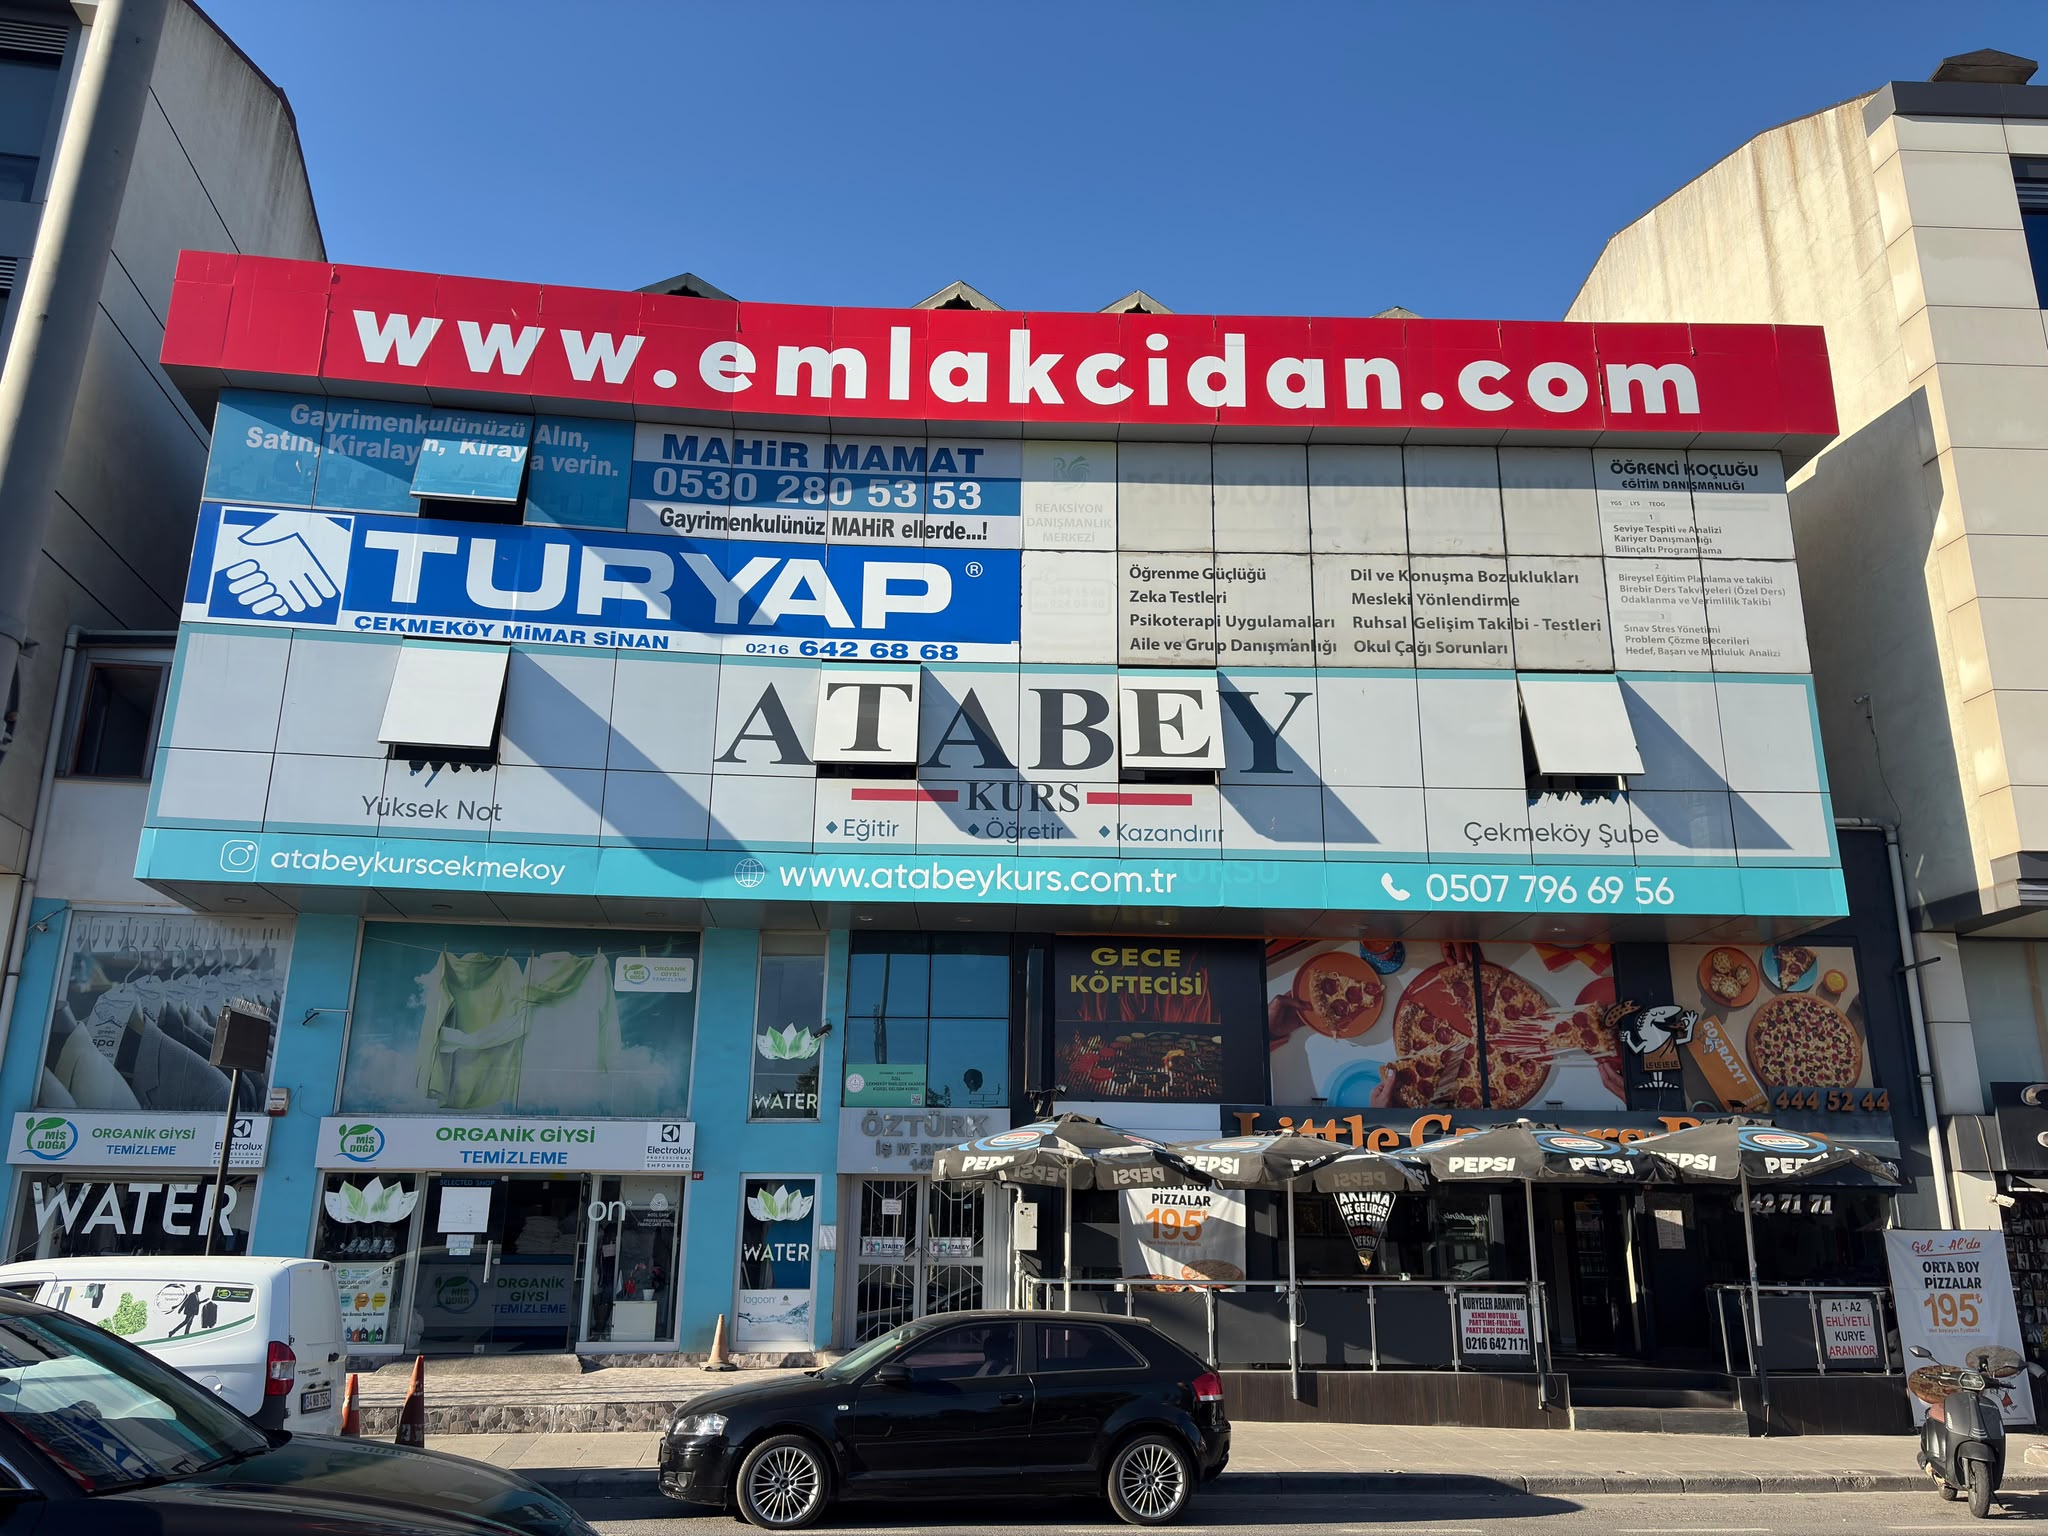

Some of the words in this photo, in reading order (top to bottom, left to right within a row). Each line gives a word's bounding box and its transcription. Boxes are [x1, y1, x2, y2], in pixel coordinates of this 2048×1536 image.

[353, 309, 1701, 416] www.emlakcidan.com
[290, 402, 526, 440] Gayrimenkulünüzü
[536, 424, 590, 452] Alın,
[246, 426, 319, 457] Satın,
[551, 453, 619, 477] verin.
[823, 442, 985, 474] MAMAT
[1610, 459, 1680, 476] ÖĞRENCİ
[1684, 460, 1759, 479] KOÇLUĞU
[653, 466, 757, 502] 0530
[776, 473, 852, 507] 280
[867, 478, 917, 509] 53
[933, 480, 982, 511] 53
[1621, 477, 1659, 489] EĞİTİM
[1662, 479, 1745, 492] DANIŞMANLIĞI
[1035, 501, 1103, 514] REAKSİYON
[659, 506, 825, 537] Gayrimenkulünüz
[902, 520, 988, 541] ellerde...!
[1026, 517, 1112, 530] DANIŞMANLIK
[1613, 524, 1644, 535] Seviye
[1645, 525, 1676, 535] Tespiti
[1688, 526, 1722, 535] Analizi
[1042, 530, 1096, 543] MERKEZİ
[1614, 534, 1648, 545] Kariyer
[1649, 535, 1713, 546] Danışmanlığı
[1615, 545, 1656, 556] Bilinçaltı
[1657, 546, 1723, 556] Programlama
[365, 529, 954, 629] TURYAP
[1129, 564, 1200, 582] Öğrenme
[1202, 566, 1266, 583] Güçlüğü
[1350, 568, 1372, 582] Dil
[1376, 571, 1394, 582] ve
[1399, 569, 1473, 586] Konuşma
[1478, 570, 1579, 584] Bozuklukları
[1618, 573, 1654, 584] Bireysel
[1656, 574, 1686, 585] Eğitim
[1687, 575, 1732, 584] Planlama
[1746, 575, 1773, 585] takibi
[1129, 590, 1166, 603] Zeka
[1170, 590, 1227, 604] Testleri
[1619, 584, 1653, 594] Birebir
[1654, 585, 1676, 594] Ders
[1678, 585, 1732, 596] Takviyeleri
[1733, 585, 1759, 596] (Özel
[1760, 586, 1786, 597] Ders)
[1351, 592, 1412, 606] Mesleki
[1416, 592, 1520, 607] Yönlendirme
[1620, 595, 1677, 605] Odaklanma
[1742, 597, 1771, 606] Takibi
[1129, 613, 1221, 631] Psikoterapi
[1225, 614, 1336, 632] Uygulamaları
[1352, 615, 1407, 629] Ruhsal
[1414, 616, 1474, 632] Gelişim
[1478, 616, 1529, 631] Takibi
[1542, 617, 1602, 632] Testleri
[1624, 624, 1650, 633] Sınav
[1651, 624, 1676, 633] Stres
[1677, 625, 1721, 634] Yönetimi
[1130, 637, 1160, 651] Aile
[1164, 640, 1182, 651] ve
[1186, 638, 1227, 655] Grup
[1230, 638, 1337, 656] Danışmanlığı
[1354, 639, 1391, 653] Okul
[1395, 639, 1432, 657] Çağı
[1435, 640, 1509, 655] Sorunları
[1625, 635, 1666, 644] Problem
[1668, 635, 1700, 647] Çözme
[1702, 636, 1750, 646] Becerileri
[746, 642, 789, 656] 0216
[799, 639, 861, 658] 642
[870, 641, 913, 660] 68
[920, 642, 960, 661] 68
[1626, 646, 1656, 656] Hedef,
[1657, 647, 1687, 657] Başarı
[1701, 648, 1745, 657] Mutluluk
[1749, 649, 1781, 657] Analizi
[714, 681, 1314, 774] ATABEY
[965, 782, 1080, 814] KURS
[362, 794, 448, 820] Yüksek
[457, 800, 503, 821] Not
[843, 818, 900, 843] Eğitir
[985, 816, 1064, 844] Öğretir
[1464, 821, 1592, 848] Çekmeköy
[1598, 822, 1660, 847] Şube
[270, 848, 566, 886] atabeykurscekmekoy
[780, 861, 1177, 896] www.atabeykurs.com.tr
[1426, 873, 1509, 902] 0507
[1519, 875, 1577, 903] 796
[1587, 876, 1623, 904] 69
[1635, 876, 1675, 905] 56
[1091, 947, 1181, 967] GECE
[1070, 969, 1202, 996] KÖFTECİSİ
[753, 1093, 817, 1109] WATER
[1776, 1091, 1818, 1111] 444
[1827, 1092, 1855, 1112] 52
[1861, 1091, 1890, 1113] 44
[861, 1110, 989, 1138] ÖZTÜRK
[44, 1129, 67, 1141] MİS
[91, 1126, 157, 1140] ORGANİK
[159, 1126, 196, 1140] GİYSİ
[355, 1135, 375, 1145] MİS
[435, 1124, 535, 1143] ORGANİK
[539, 1125, 596, 1144] GİYSİ
[106, 1143, 177, 1156] TEMİZLEME
[459, 1147, 567, 1166] TEMİZLEME
[647, 1145, 692, 1155] Electrolux
[1448, 1157, 1516, 1173] PEPSI
[1569, 1157, 1636, 1175] PEPSI
[1151, 1191, 1211, 1207] PİZZALAR
[1779, 1194, 1801, 1213] 71
[1808, 1195, 1832, 1214] 71
[32, 1181, 239, 1236] WATER
[1341, 1205, 1353, 1215] NE
[743, 1243, 810, 1262] WATER
[1911, 1239, 1934, 1254] Gel
[1948, 1237, 1981, 1250] Al'da
[1922, 1261, 1955, 1273] ORTA
[1957, 1261, 1980, 1273] BOY
[496, 1275, 565, 1290] ORGANİK
[1924, 1273, 1982, 1289] PİZZALAR
[509, 1287, 549, 1302] GİYSİ
[743, 1295, 775, 1305] lagoon
[492, 1302, 567, 1315] TEMİZLEME
[1463, 1297, 1493, 1310] KURYELER
[1494, 1297, 1525, 1310] ARANIYOR
[1831, 1302, 1842, 1312] A1
[1850, 1302, 1862, 1312] A2
[1471, 1311, 1487, 1319] KENDİ
[1825, 1312, 1871, 1327] EHLİYETLİ
[1483, 1327, 1495, 1336] BAŞI
[1835, 1331, 1866, 1342] KURYE
[1465, 1337, 1488, 1350] 0216
[1490, 1337, 1507, 1350] 642
[1508, 1337, 1518, 1350] 71
[1519, 1338, 1529, 1351] 71
[1829, 1344, 1876, 1357] ARANIYOR
